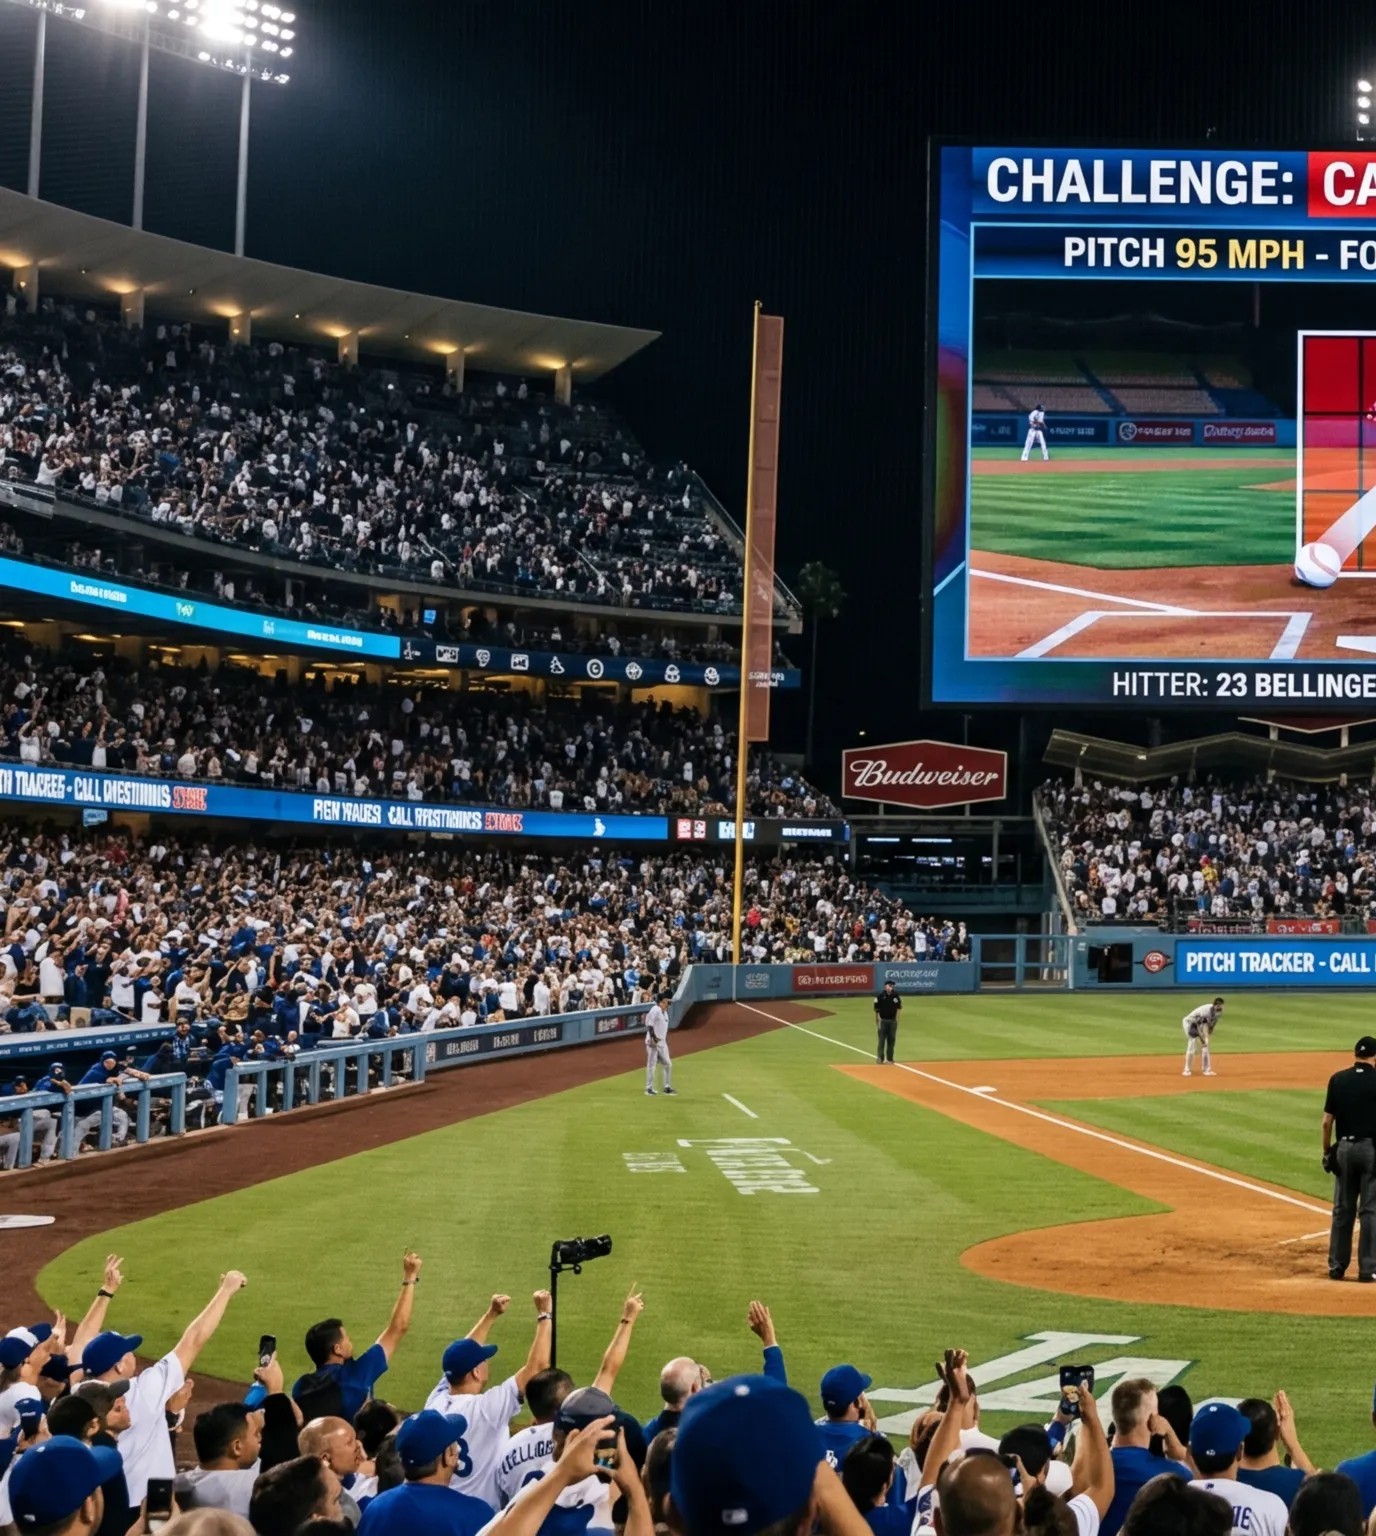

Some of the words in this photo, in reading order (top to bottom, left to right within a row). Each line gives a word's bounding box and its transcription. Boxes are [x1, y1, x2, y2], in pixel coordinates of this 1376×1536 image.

[987, 157, 1293, 205] CHALLENGE:
[1064, 237, 1165, 268] PITCH
[1175, 238, 1218, 269] 95
[1228, 239, 1304, 270] MPH
[1113, 671, 1208, 697] HITTER:
[1216, 672, 1248, 698] 23
[849, 759, 999, 787] Budweiser
[1186, 952, 1236, 973] PITCH
[1238, 952, 1315, 973] TRACKER
[1329, 952, 1371, 973] CALL
